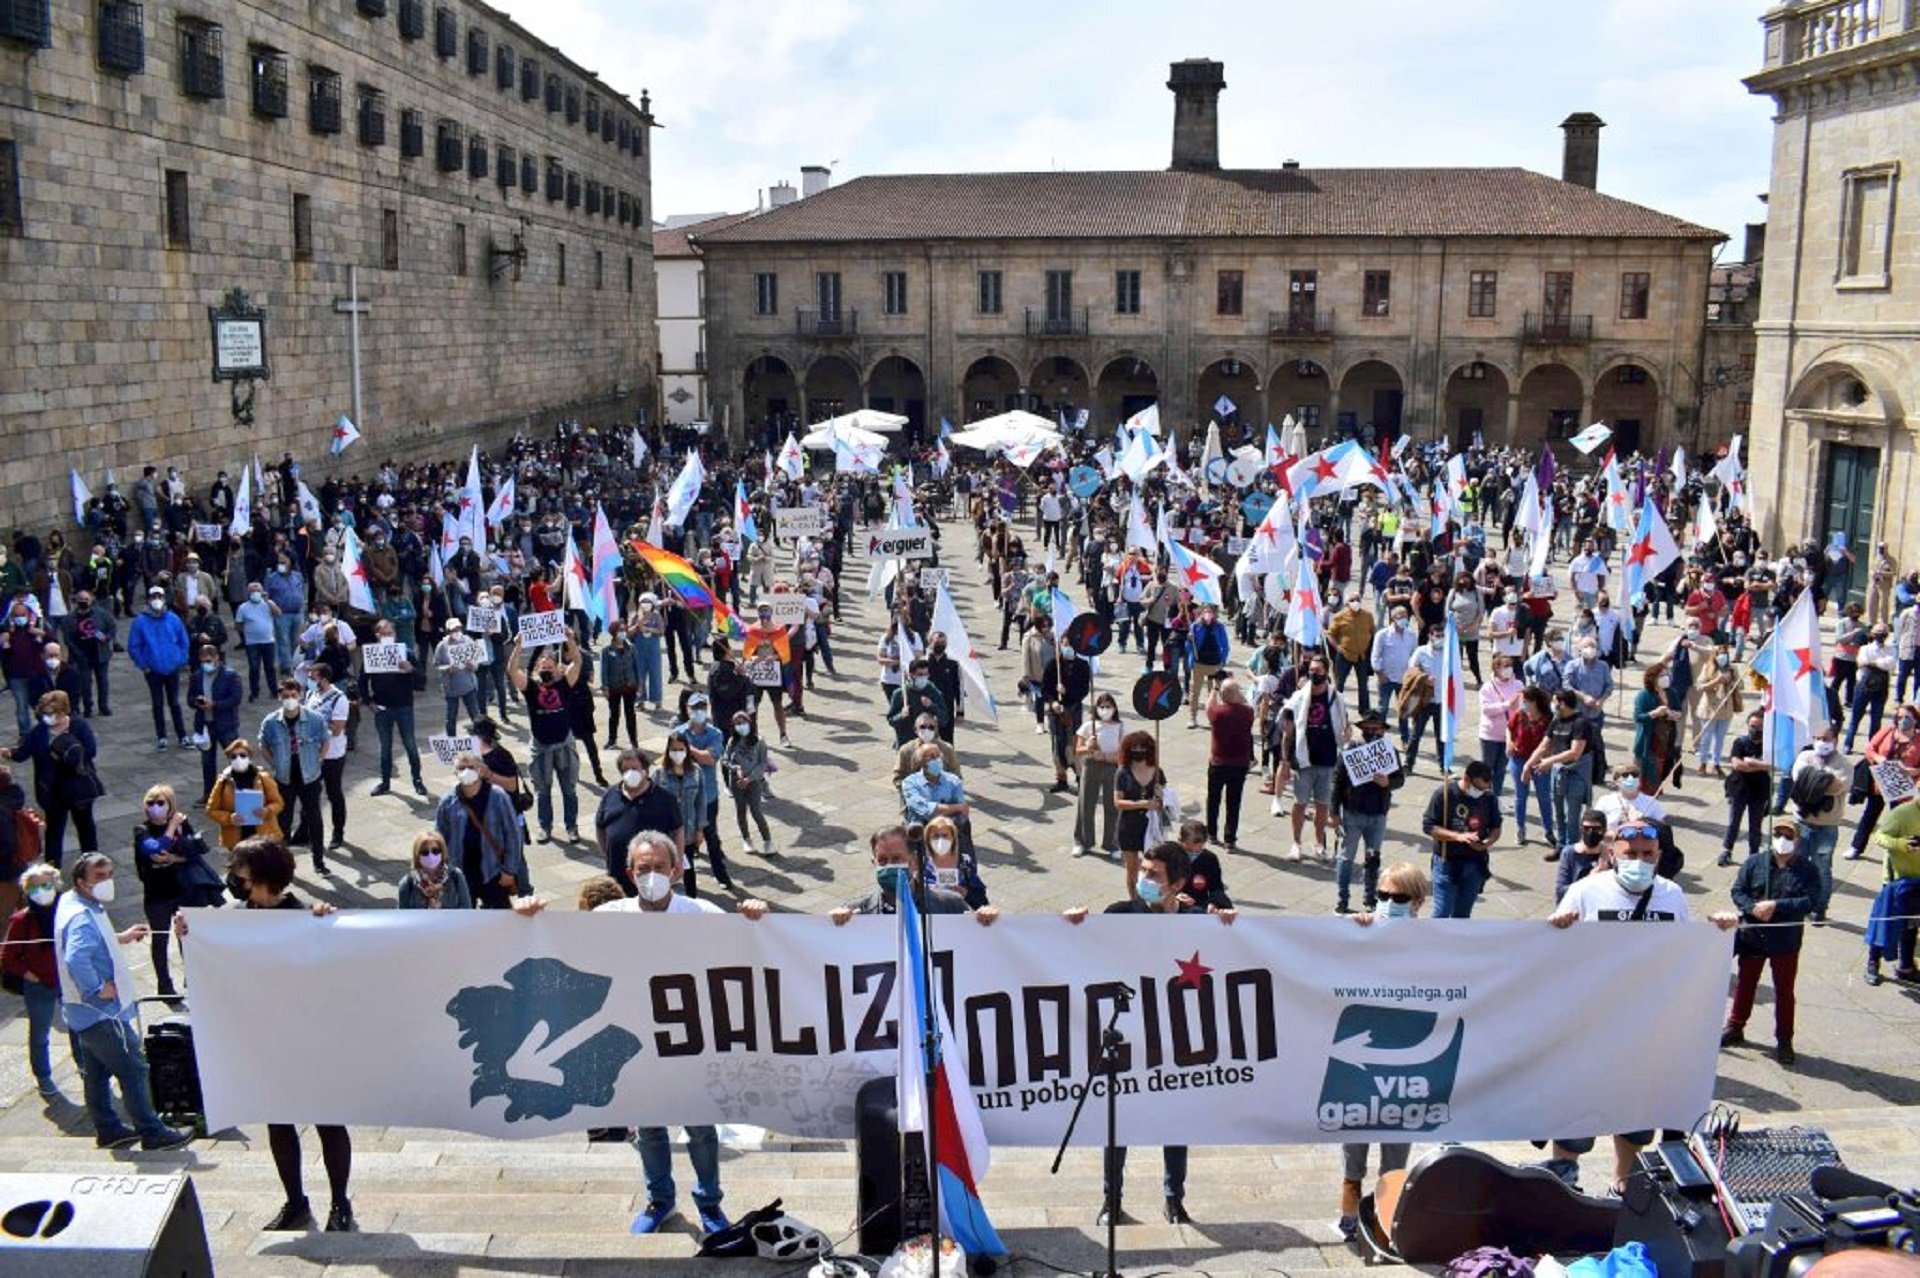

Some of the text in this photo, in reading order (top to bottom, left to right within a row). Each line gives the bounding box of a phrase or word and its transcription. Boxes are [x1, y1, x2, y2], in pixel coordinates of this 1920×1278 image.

[869, 536, 926, 555] Kerguer
[1333, 985, 1468, 1001] www.viagalega.gal
[976, 1090, 1014, 1110] un
[1020, 1078, 1086, 1112] pobo
[1147, 1063, 1255, 1093] dereitos
[1319, 1095, 1449, 1132] galega
